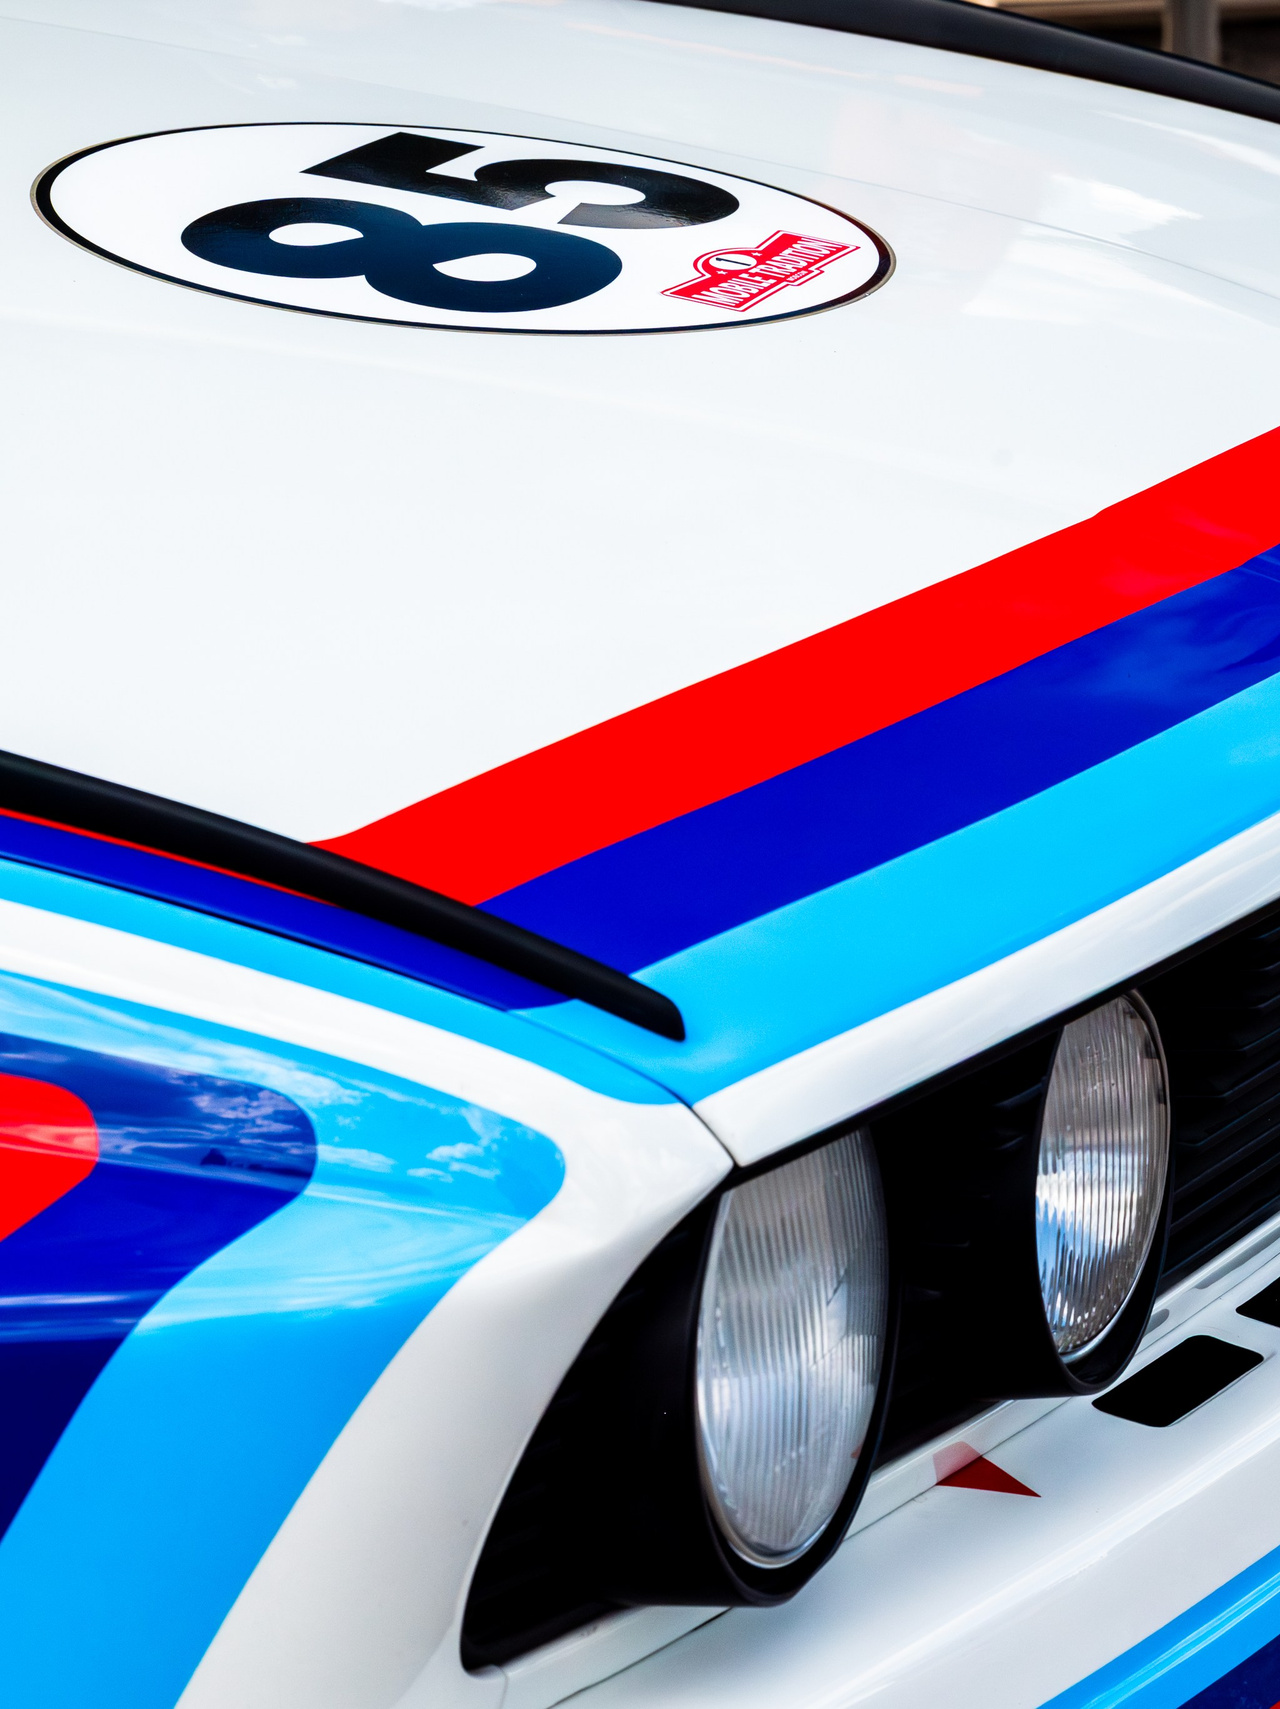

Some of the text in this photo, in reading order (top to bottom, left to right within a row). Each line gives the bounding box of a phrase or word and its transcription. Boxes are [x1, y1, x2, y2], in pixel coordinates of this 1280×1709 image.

[181, 132, 739, 313] 85
[691, 237, 844, 306] MOBILE TRADITION
[715, 256, 752, 267] 1
